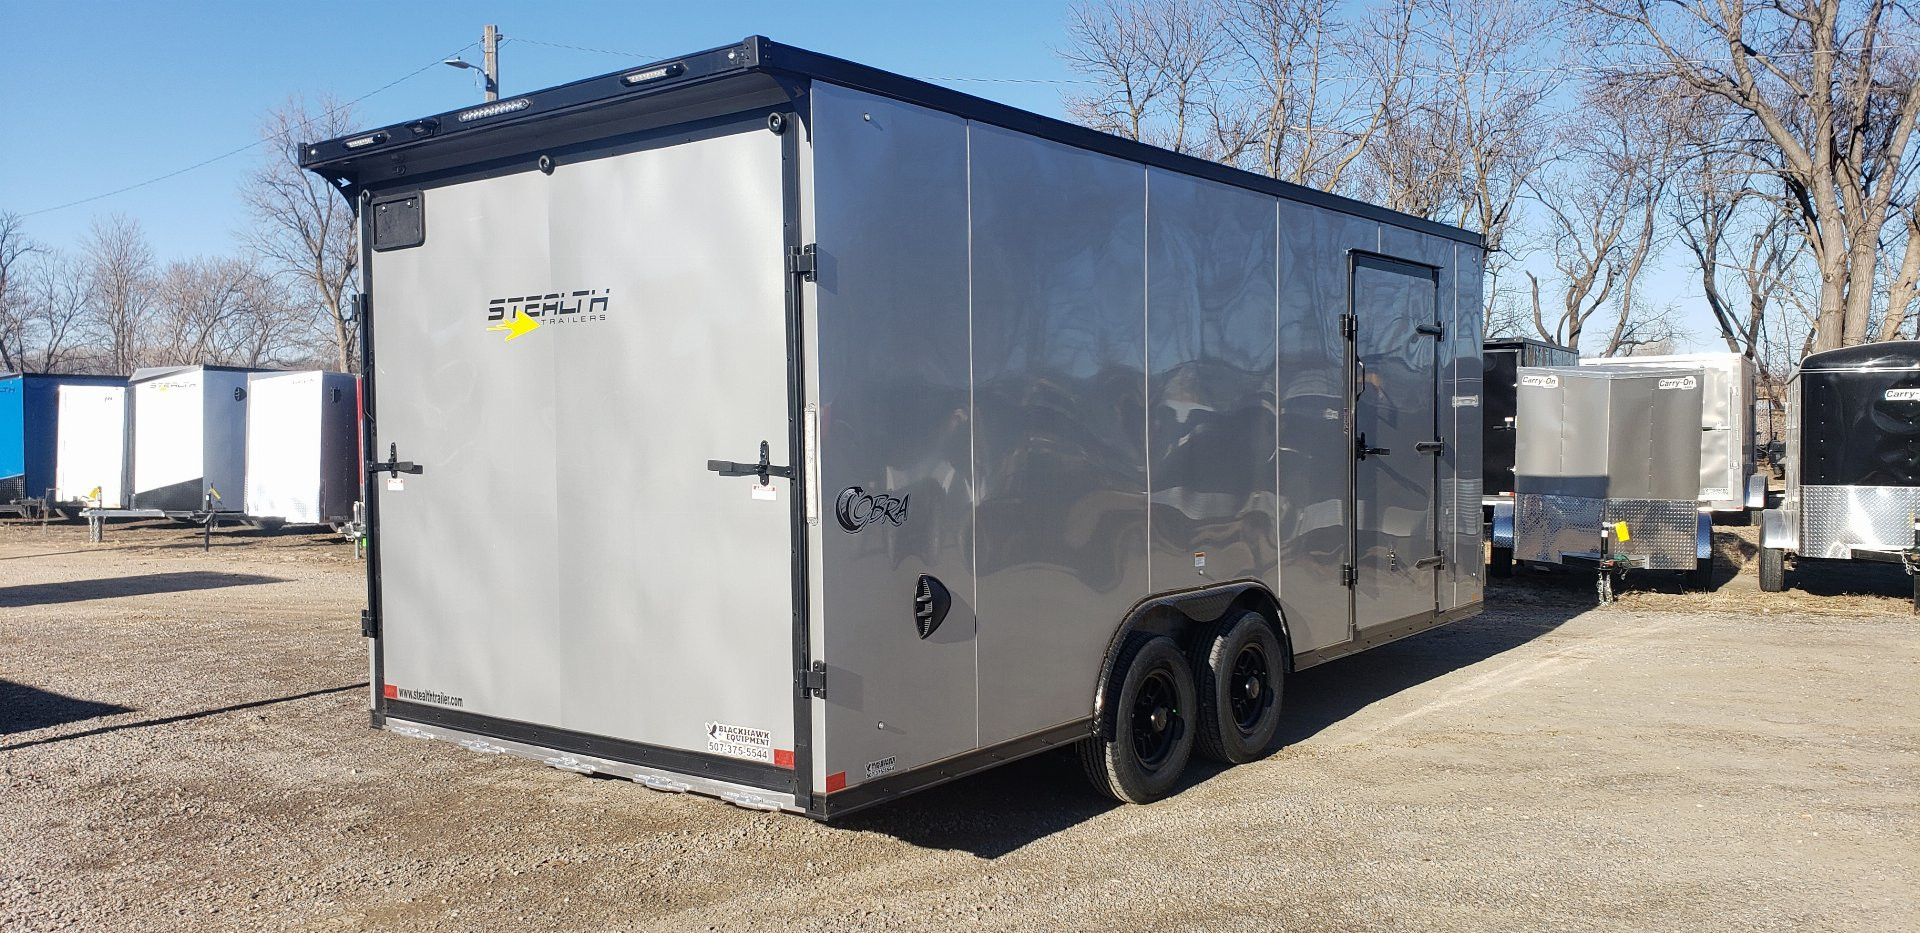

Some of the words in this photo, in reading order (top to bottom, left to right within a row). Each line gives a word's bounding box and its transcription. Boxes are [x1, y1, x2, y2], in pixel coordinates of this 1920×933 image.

[488, 288, 610, 321] STEALTH
[540, 314, 607, 325] TRAILERS
[1522, 376, 1557, 386] Carry-On
[1659, 378, 1694, 388] Carry-On
[834, 486, 911, 534] COBRA
[398, 688, 464, 707] www.stealthtrailer.com
[719, 725, 770, 739] BLACKHAWK
[726, 734, 770, 746] EQUIPMENT
[709, 741, 768, 759] 507-375-5544
